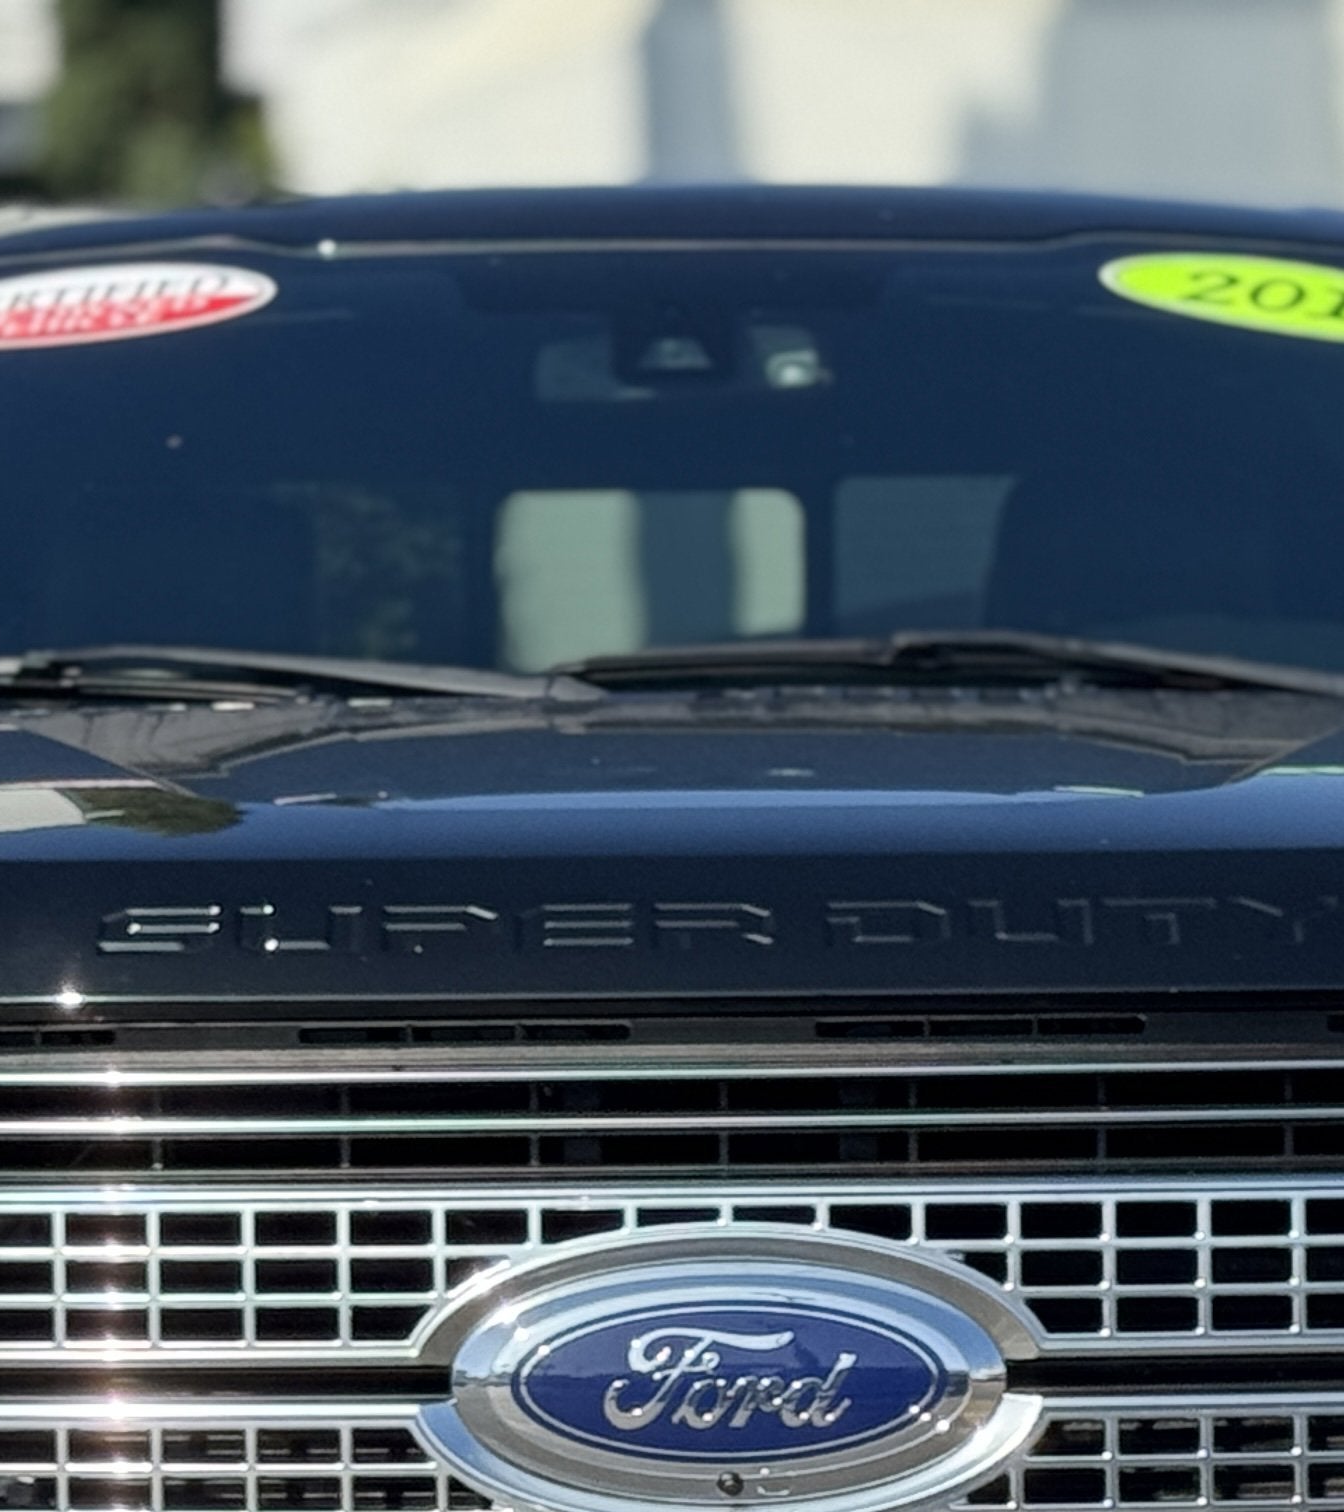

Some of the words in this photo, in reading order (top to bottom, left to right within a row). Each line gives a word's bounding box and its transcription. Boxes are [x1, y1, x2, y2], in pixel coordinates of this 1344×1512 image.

[96, 902, 776, 953] SUPER
[824, 896, 1340, 947] DUTY
[603, 1326, 857, 1431] Ford
